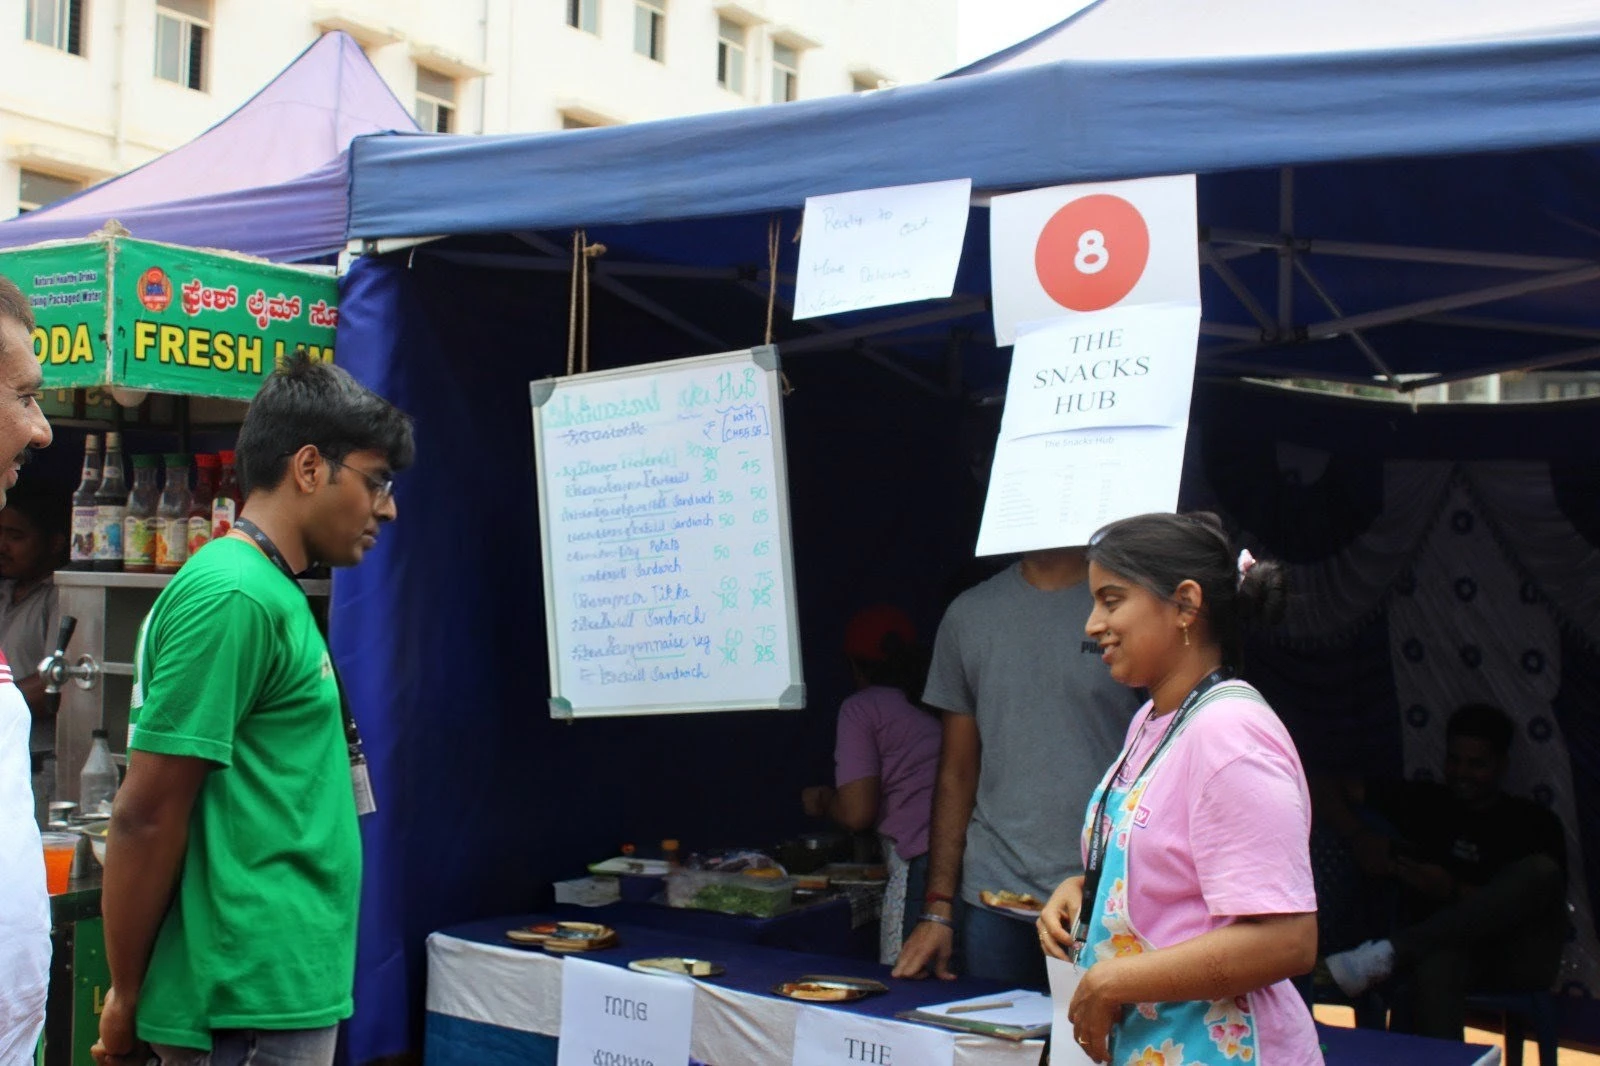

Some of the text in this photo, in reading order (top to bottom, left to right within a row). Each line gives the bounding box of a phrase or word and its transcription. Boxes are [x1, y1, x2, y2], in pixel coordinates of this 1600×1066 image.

[1074, 229, 1110, 275] 8
[48, 292, 80, 307] Packaged
[81, 289, 102, 302] Water
[31, 322, 95, 366] ODA
[134, 320, 263, 375] FRESH
[1069, 328, 1124, 354] THE
[1033, 355, 1150, 389] SNACKS
[1054, 390, 1116, 415] HUB
[1063, 437, 1092, 447] Snacks
[1095, 436, 1115, 445] Hub
[750, 486, 767, 500] 50
[752, 509, 769, 524] 65
[753, 540, 770, 556] 65
[844, 1037, 892, 1066] THE
